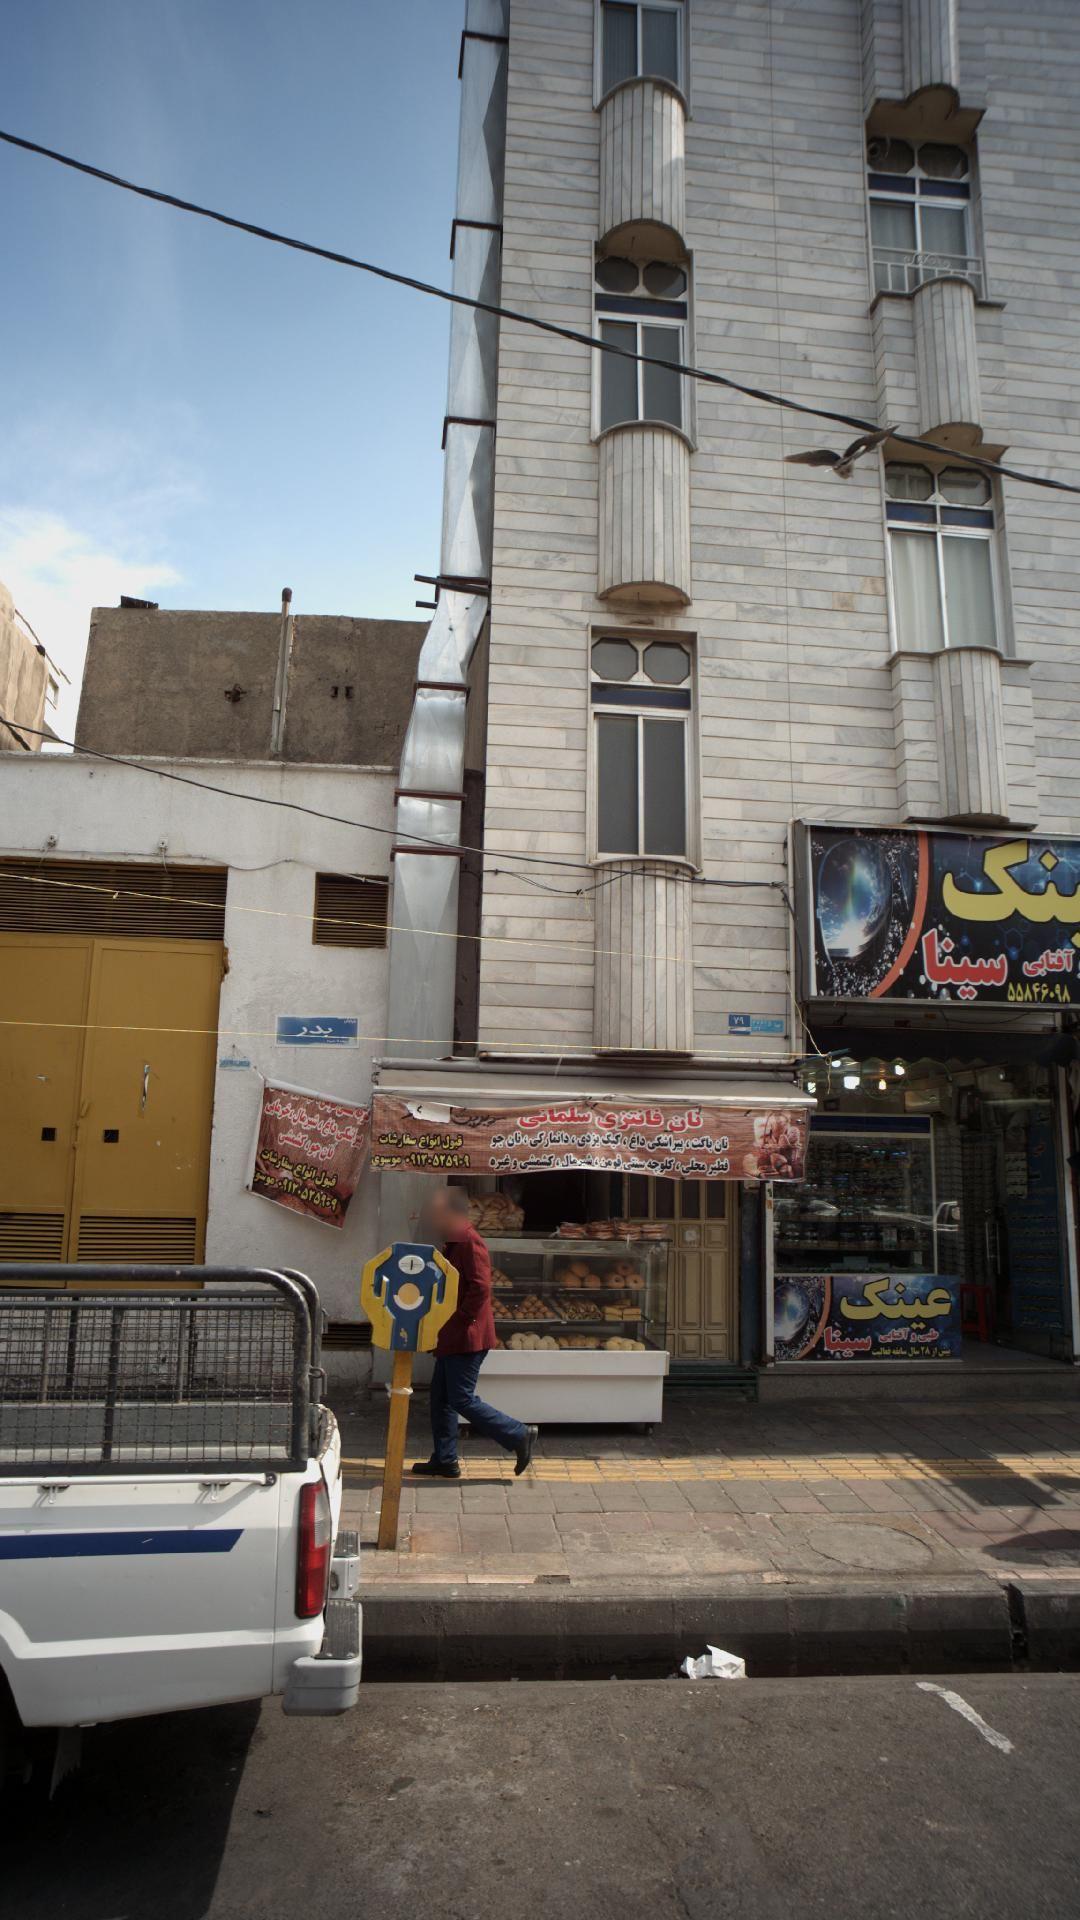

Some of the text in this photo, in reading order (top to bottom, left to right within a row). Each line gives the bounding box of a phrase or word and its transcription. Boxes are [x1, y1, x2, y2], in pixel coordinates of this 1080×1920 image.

[922, 928, 1008, 999] سینا
[1022, 949, 1075, 977] آفتابی
[1007, 982, 1071, 1002] ۵۵۸۴۶۰۹۸
[296, 1025, 333, 1038] بدر
[518, 1107, 592, 1128] سلمانی
[596, 1108, 664, 1131] فانتزی
[667, 1109, 703, 1132] نان
[379, 1132, 463, 1150] قبول انواع سفارشات
[490, 1134, 505, 1149] جو
[507, 1131, 522, 1149] نان
[647, 1135, 684, 1153] پیراشکی
[714, 1136, 728, 1153] نان
[261, 1149, 338, 1189] قبول انواع سفارشات
[371, 1154, 402, 1168] موسوی
[490, 1154, 510, 1170] غیره
[511, 1159, 517, 1170] و
[519, 1154, 554, 1170] کشمشی
[647, 1157, 675, 1175] کلوچه
[707, 1158, 729, 1176] فطیر
[254, 1172, 276, 1187] موسو
[840, 1277, 952, 1330] عینک
[824, 1326, 872, 1358] سینا
